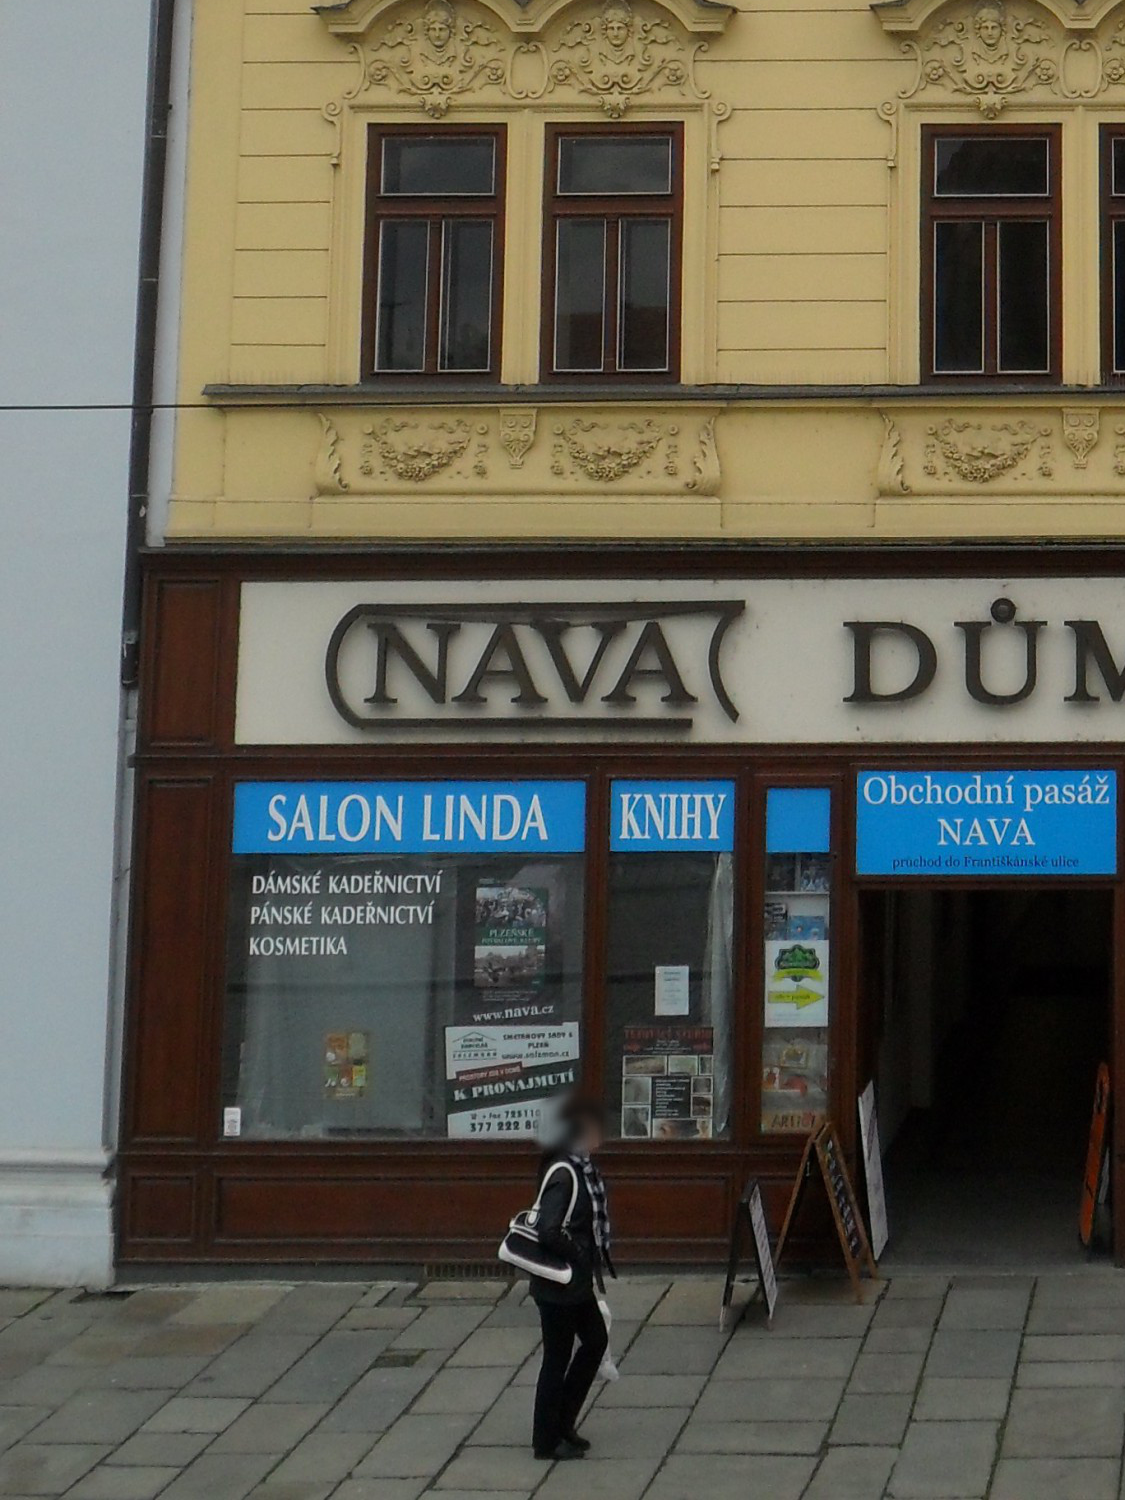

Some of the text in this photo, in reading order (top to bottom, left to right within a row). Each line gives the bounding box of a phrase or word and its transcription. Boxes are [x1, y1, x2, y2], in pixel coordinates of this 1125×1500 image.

[365, 622, 697, 704] NAVA
[863, 775, 1110, 812] Obchodní pasáž
[267, 794, 549, 842] SALON LINDA
[618, 793, 726, 841] KNIHY
[937, 818, 1036, 846] NAVA
[945, 855, 960, 868] do
[1051, 855, 1079, 867] ulice
[252, 870, 443, 895] DÁMSKÉ KADEŘNICTVÍ
[250, 900, 435, 925] PÁNSKÉ KADEŘNICTVÍ
[249, 936, 348, 956] KOSMETIKA
[472, 1005, 554, 1023] www.nava.cz
[454, 1067, 574, 1102] K PRONAJMUTÍ
[470, 1122, 492, 1133] 377
[497, 1120, 520, 1132] 222
